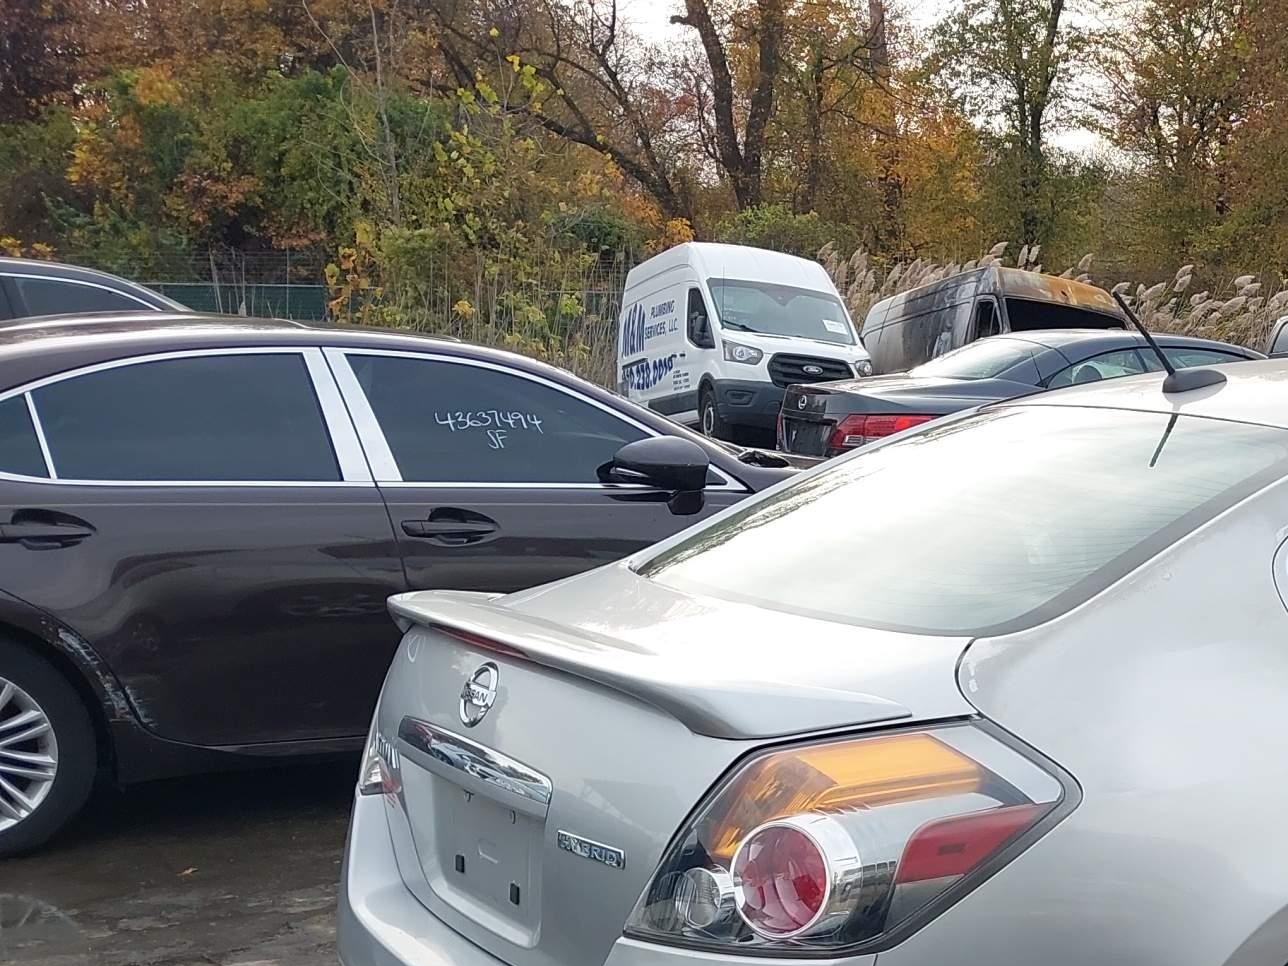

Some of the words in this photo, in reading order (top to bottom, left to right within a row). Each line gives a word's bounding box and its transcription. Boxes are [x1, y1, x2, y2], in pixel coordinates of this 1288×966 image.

[650, 299, 675, 319] PLUMBING
[622, 302, 646, 358] M&M
[434, 410, 543, 434] 43637494
[559, 833, 619, 867] HYBRID
